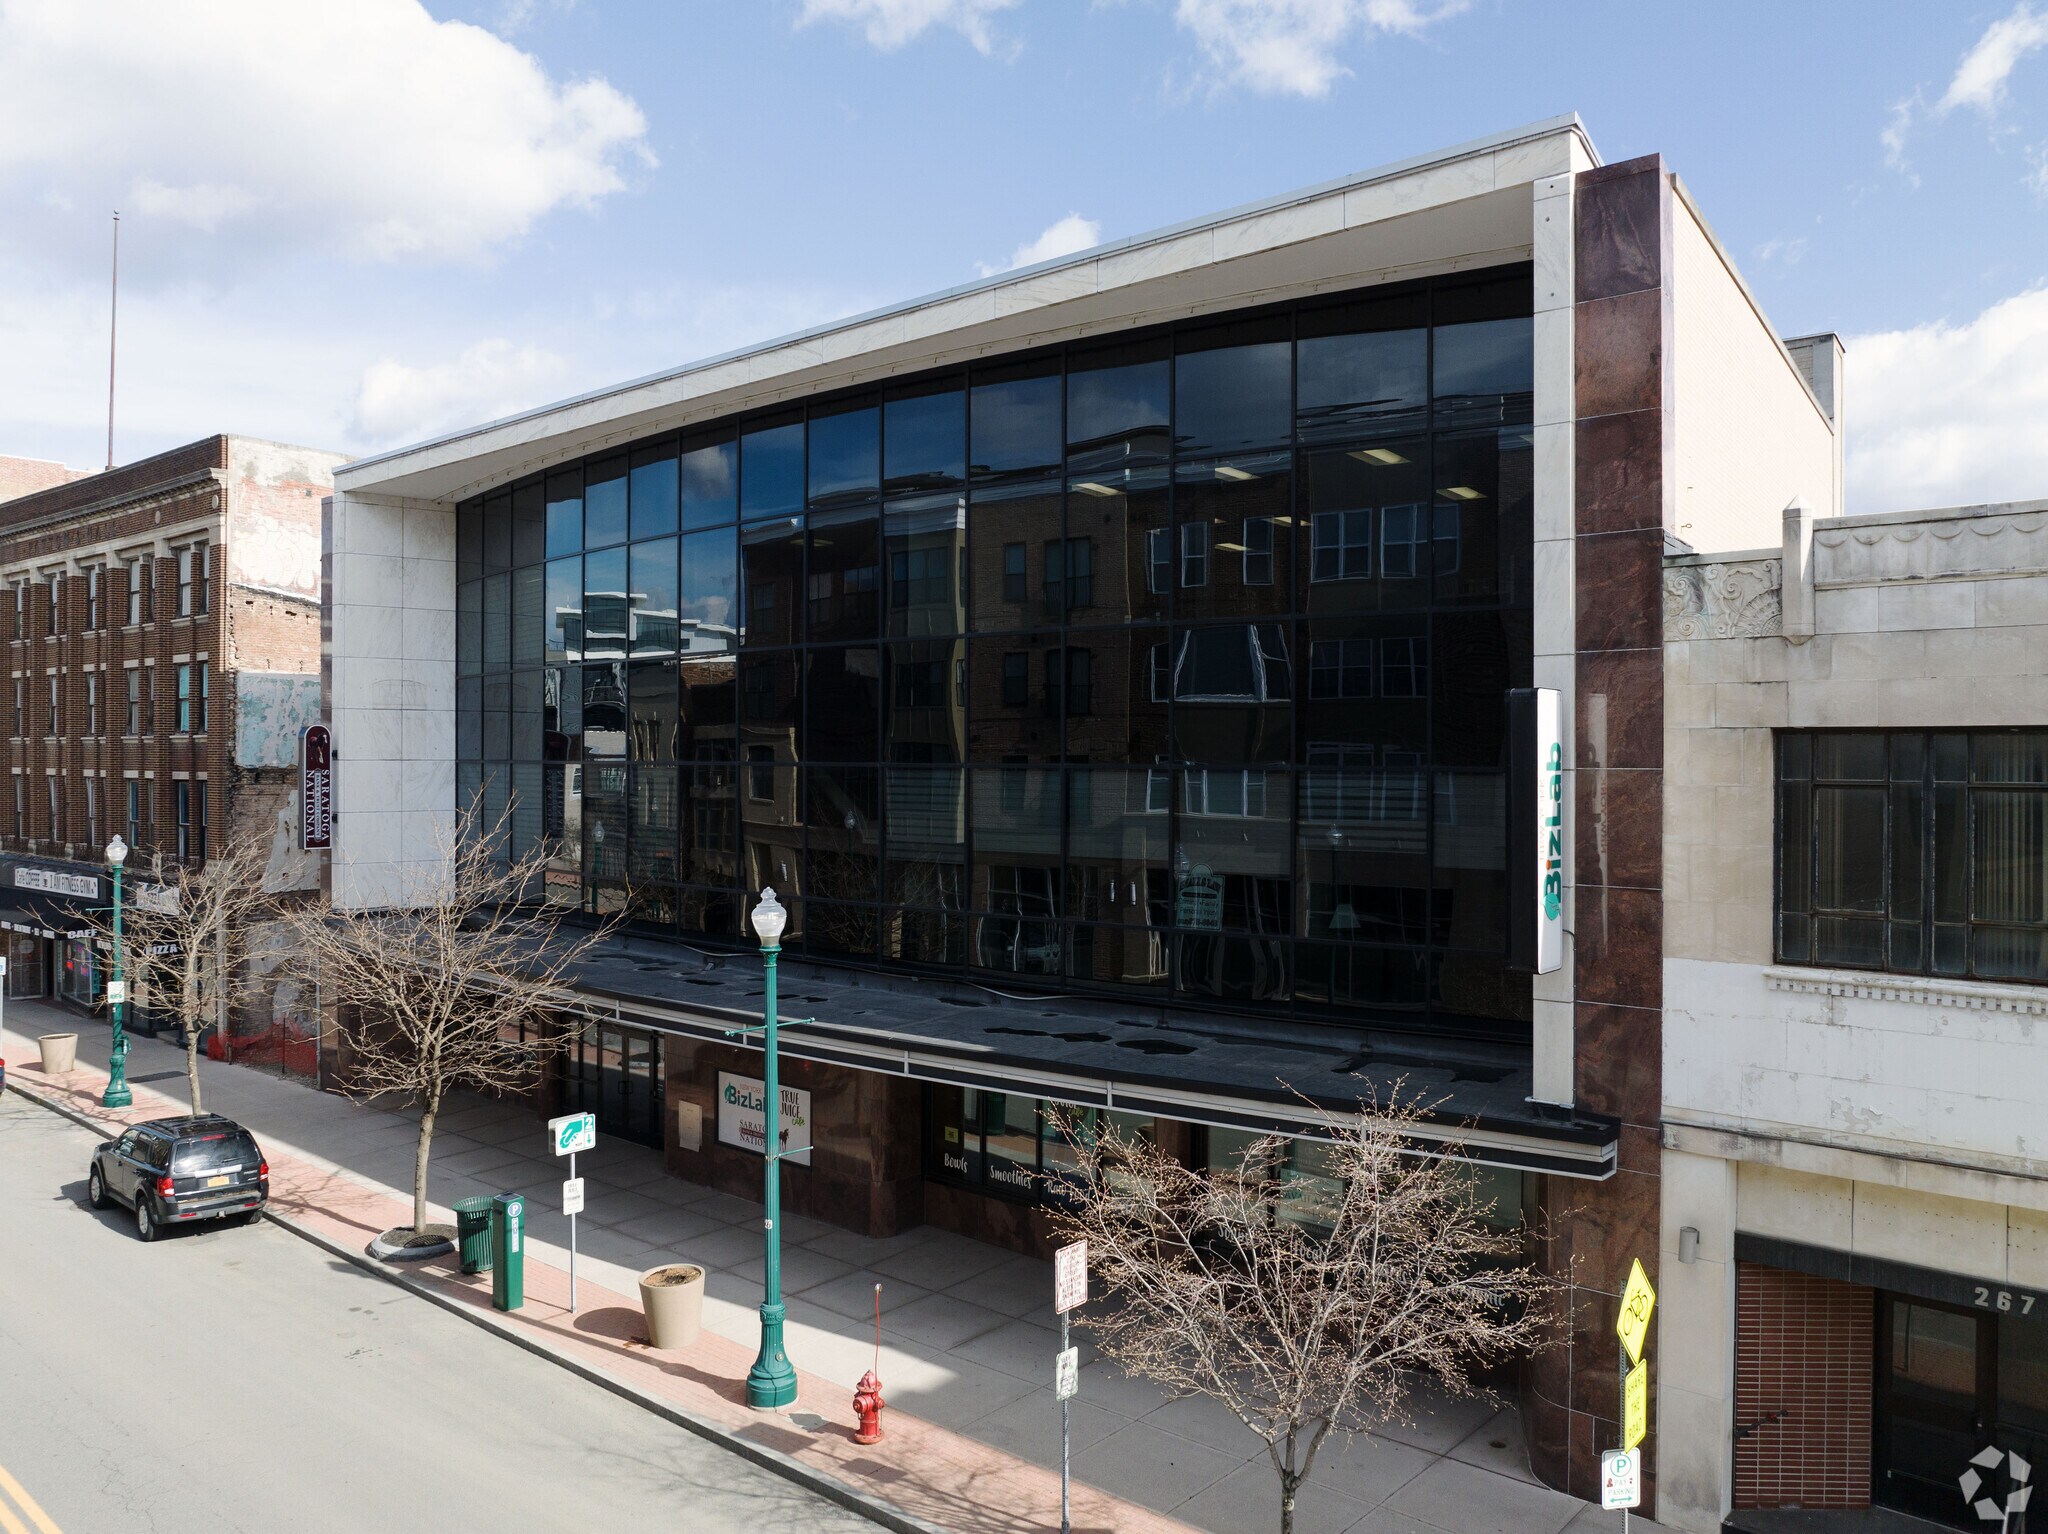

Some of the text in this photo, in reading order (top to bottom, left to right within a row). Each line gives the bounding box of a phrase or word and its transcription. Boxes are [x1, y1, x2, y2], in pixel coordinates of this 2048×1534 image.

[306, 769, 315, 842] NATIONAL
[321, 769, 330, 841] SARATOGA
[1543, 742, 1562, 903] BizLab
[26, 871, 40, 888] COFFEE
[61, 877, 79, 895] FITNESS
[146, 943, 178, 956] PIZZA
[781, 1089, 800, 1105] TRUE
[780, 1103, 801, 1119] JUICE
[585, 1117, 593, 1130] 2
[944, 1152, 968, 1174] Bowls
[990, 1164, 1032, 1190] Smoothies
[1974, 1286, 2036, 1315] 267
[1627, 1371, 1644, 1398] SHARE
[1631, 1396, 1640, 1413] THE
[1628, 1417, 1643, 1439] ROAD
[1616, 1460, 1627, 1473] P
[1607, 1487, 1635, 1497] PARKING
